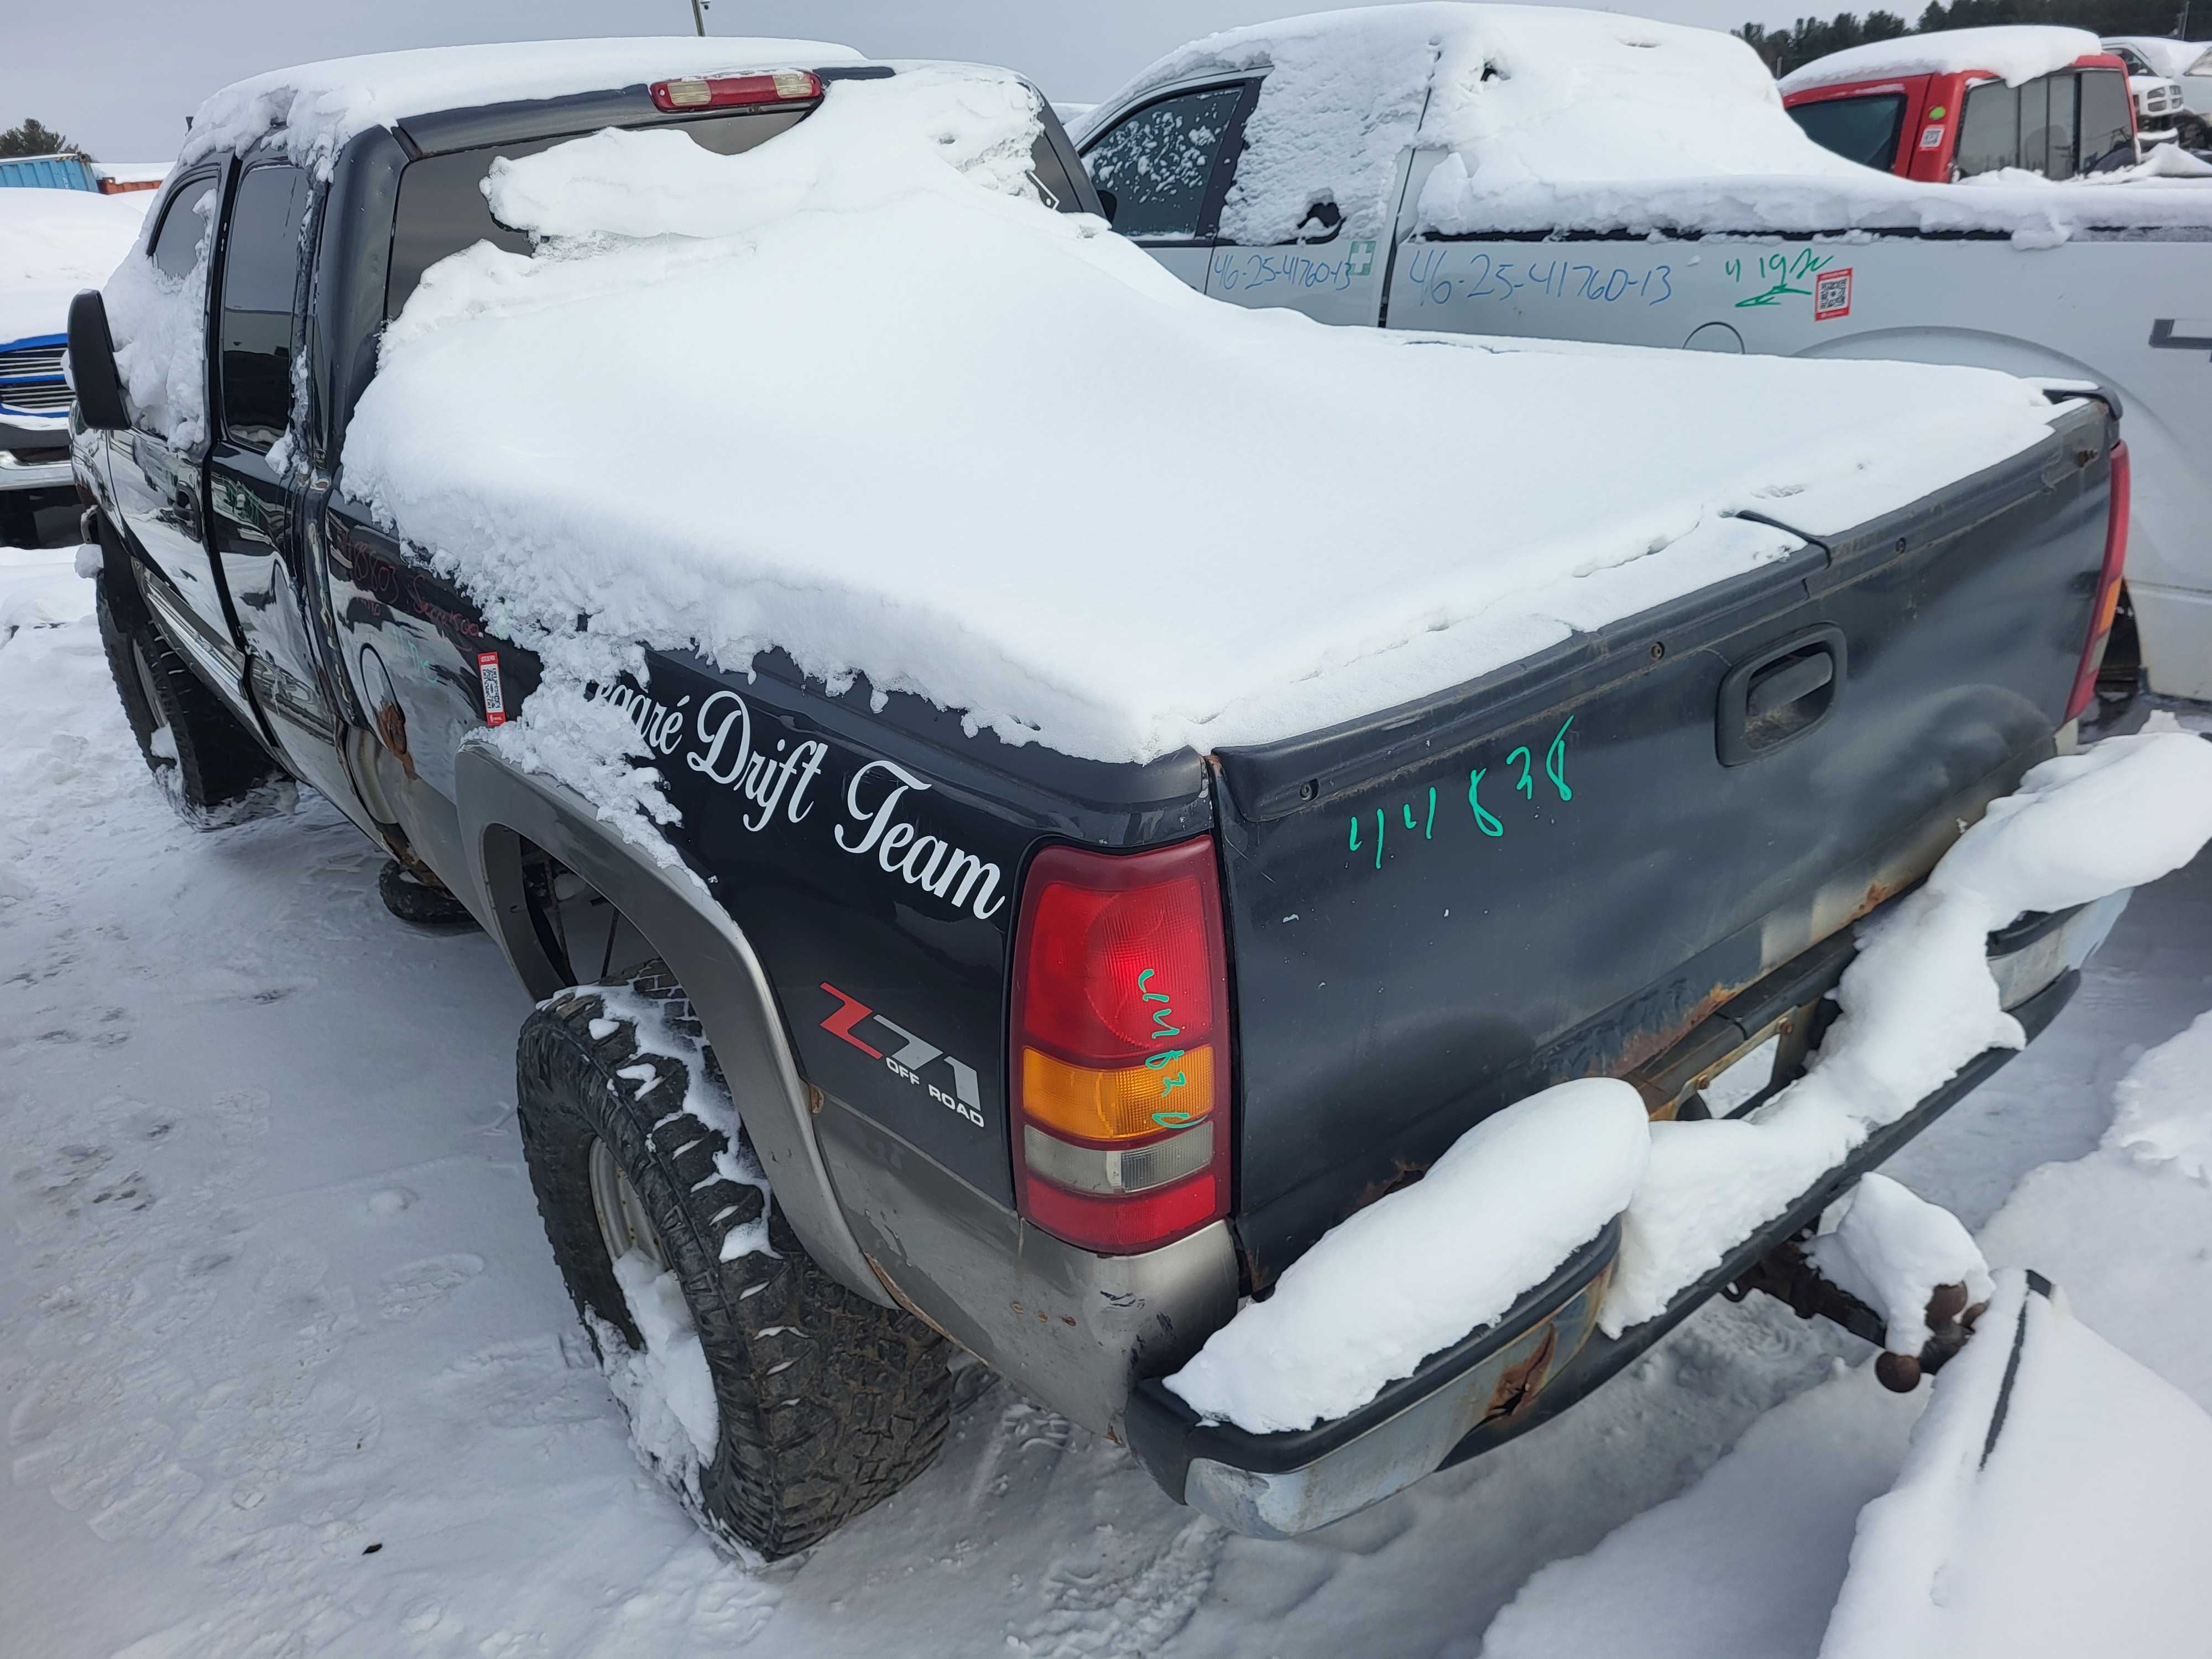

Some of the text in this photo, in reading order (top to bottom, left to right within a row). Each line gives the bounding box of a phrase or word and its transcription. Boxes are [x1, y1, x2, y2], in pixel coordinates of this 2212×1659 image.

[686, 690, 829, 832] Drift
[834, 759, 1006, 920] Team
[818, 982, 982, 1112] Z71
[885, 1057, 985, 1128] OFF ROAD
